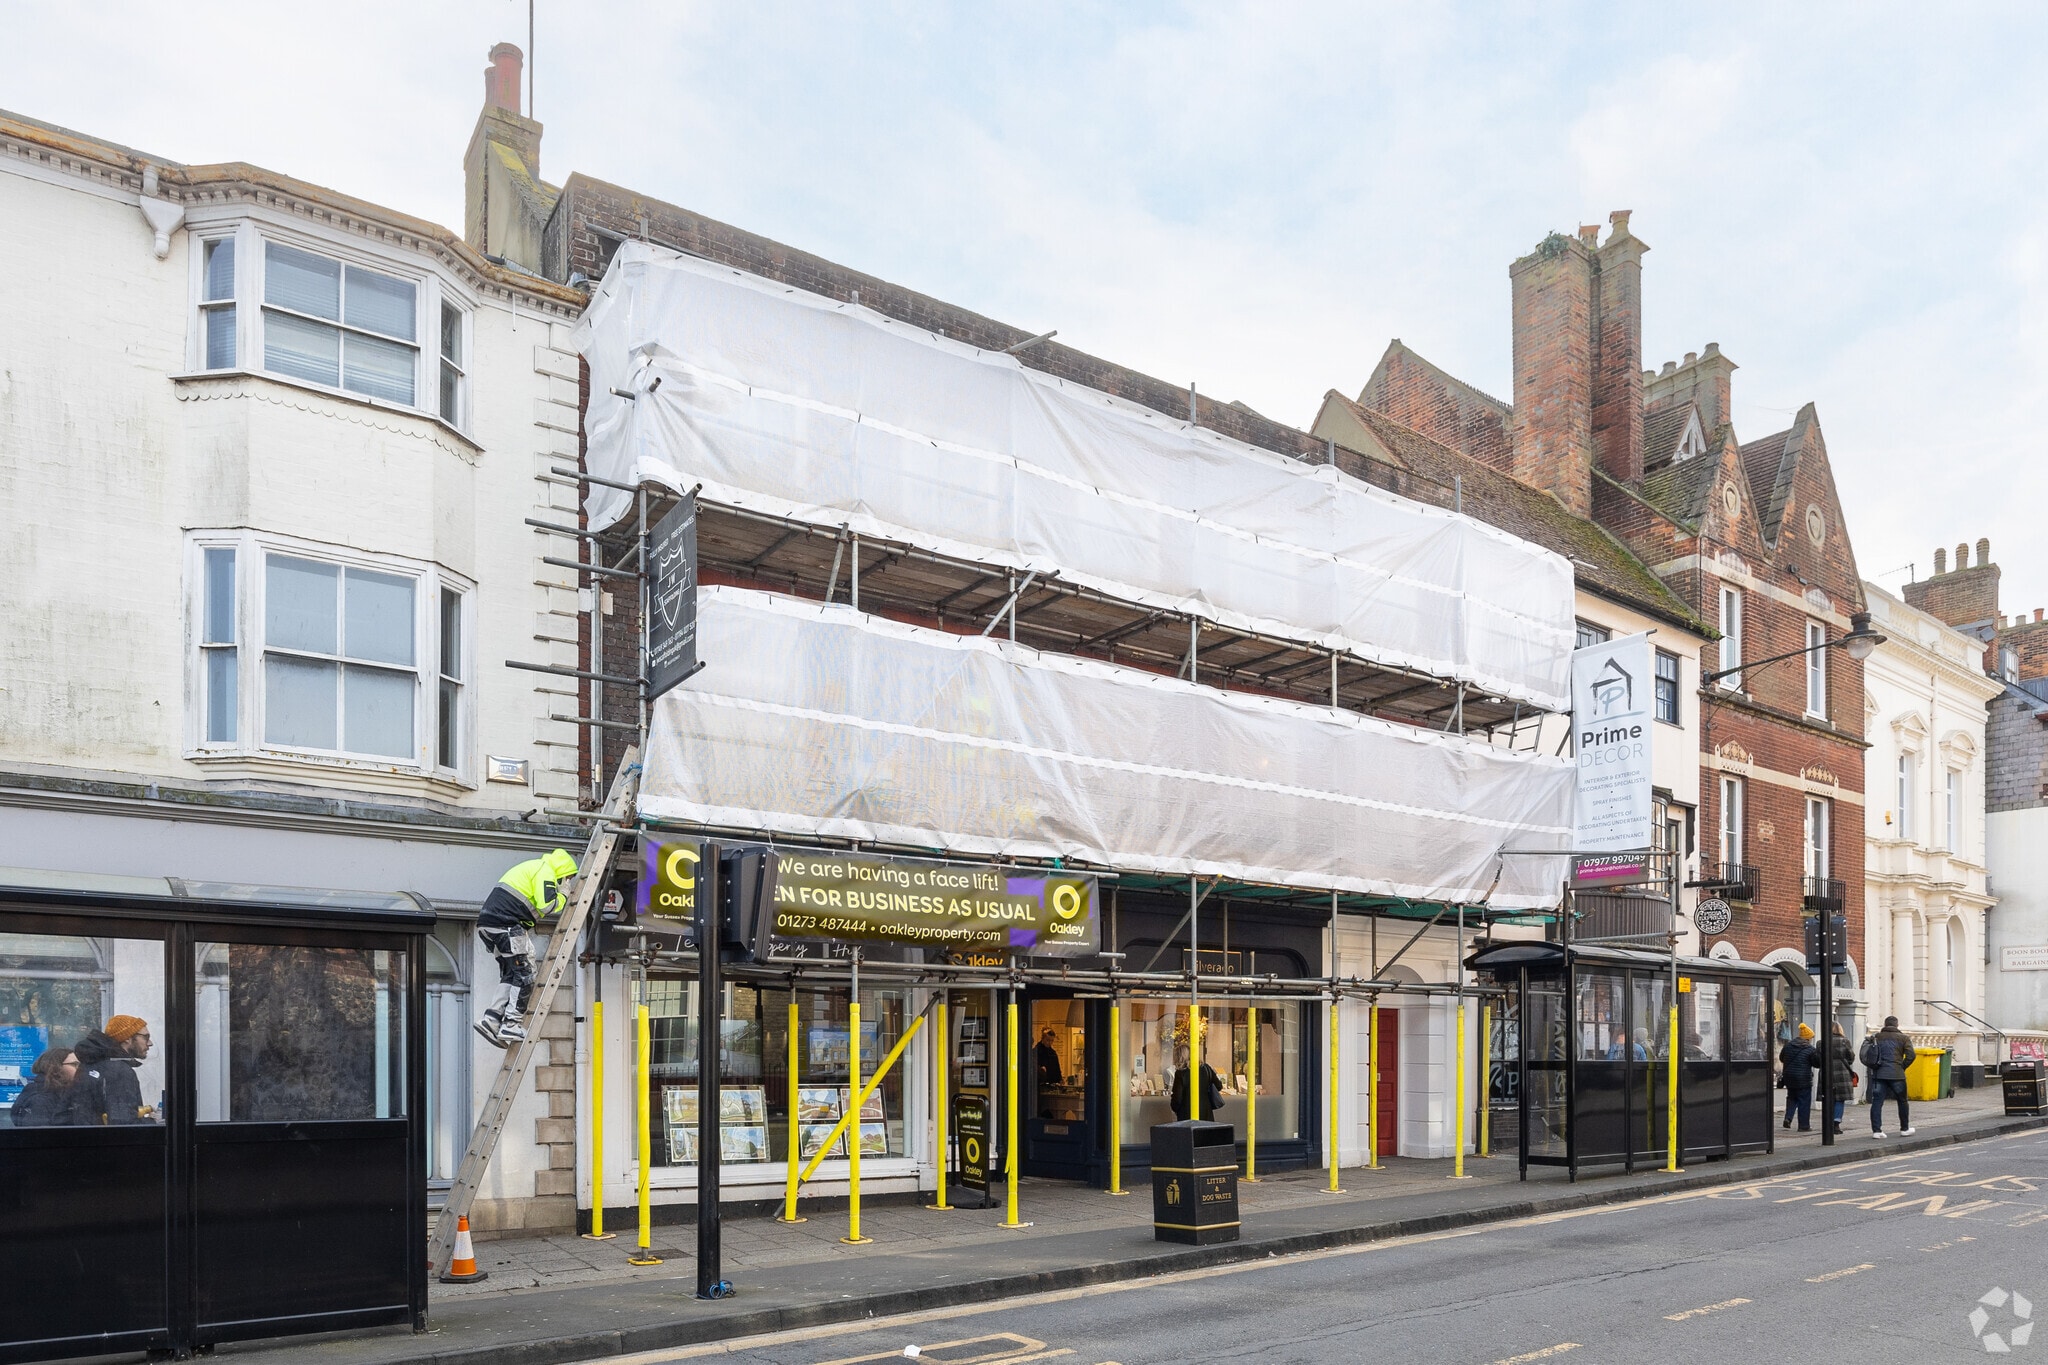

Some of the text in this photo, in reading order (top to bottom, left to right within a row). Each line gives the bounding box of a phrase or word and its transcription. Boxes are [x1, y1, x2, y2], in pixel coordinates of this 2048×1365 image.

[1581, 725, 1642, 748] Prime
[1580, 743, 1643, 768] DECOR
[1584, 776, 1609, 784] INTERIOR
[1615, 770, 1640, 780] EXTERIOR
[1578, 777, 1646, 793] DECORATING SPECIALISTS
[1609, 795, 1632, 803] FINISHES
[1578, 816, 1647, 831] DECORATING UNDERTAKEN
[1602, 812, 1624, 820] ASPECTS
[1579, 832, 1644, 845] PROPERTY MAINTENANCE
[1584, 857, 1610, 868] 07977
[1612, 854, 1645, 864] 997049
[778, 858, 999, 891] We are having a face lift!
[659, 893, 694, 908] Oakl
[800, 887, 842, 907] FOR
[846, 890, 944, 914] BUSINESS
[948, 898, 972, 916] AS
[976, 900, 1036, 921] USUAL
[777, 914, 1001, 941] 01273 487444 oakleyproperty.com
[1050, 922, 1085, 937] Oakley
[1196, 960, 1234, 974] ilverao
[965, 1165, 983, 1178] Oakley
[1206, 1177, 1227, 1185] LITTER
[1857, 1170, 2048, 1192] BUS
[1202, 1192, 1232, 1202] DOG WASTE
